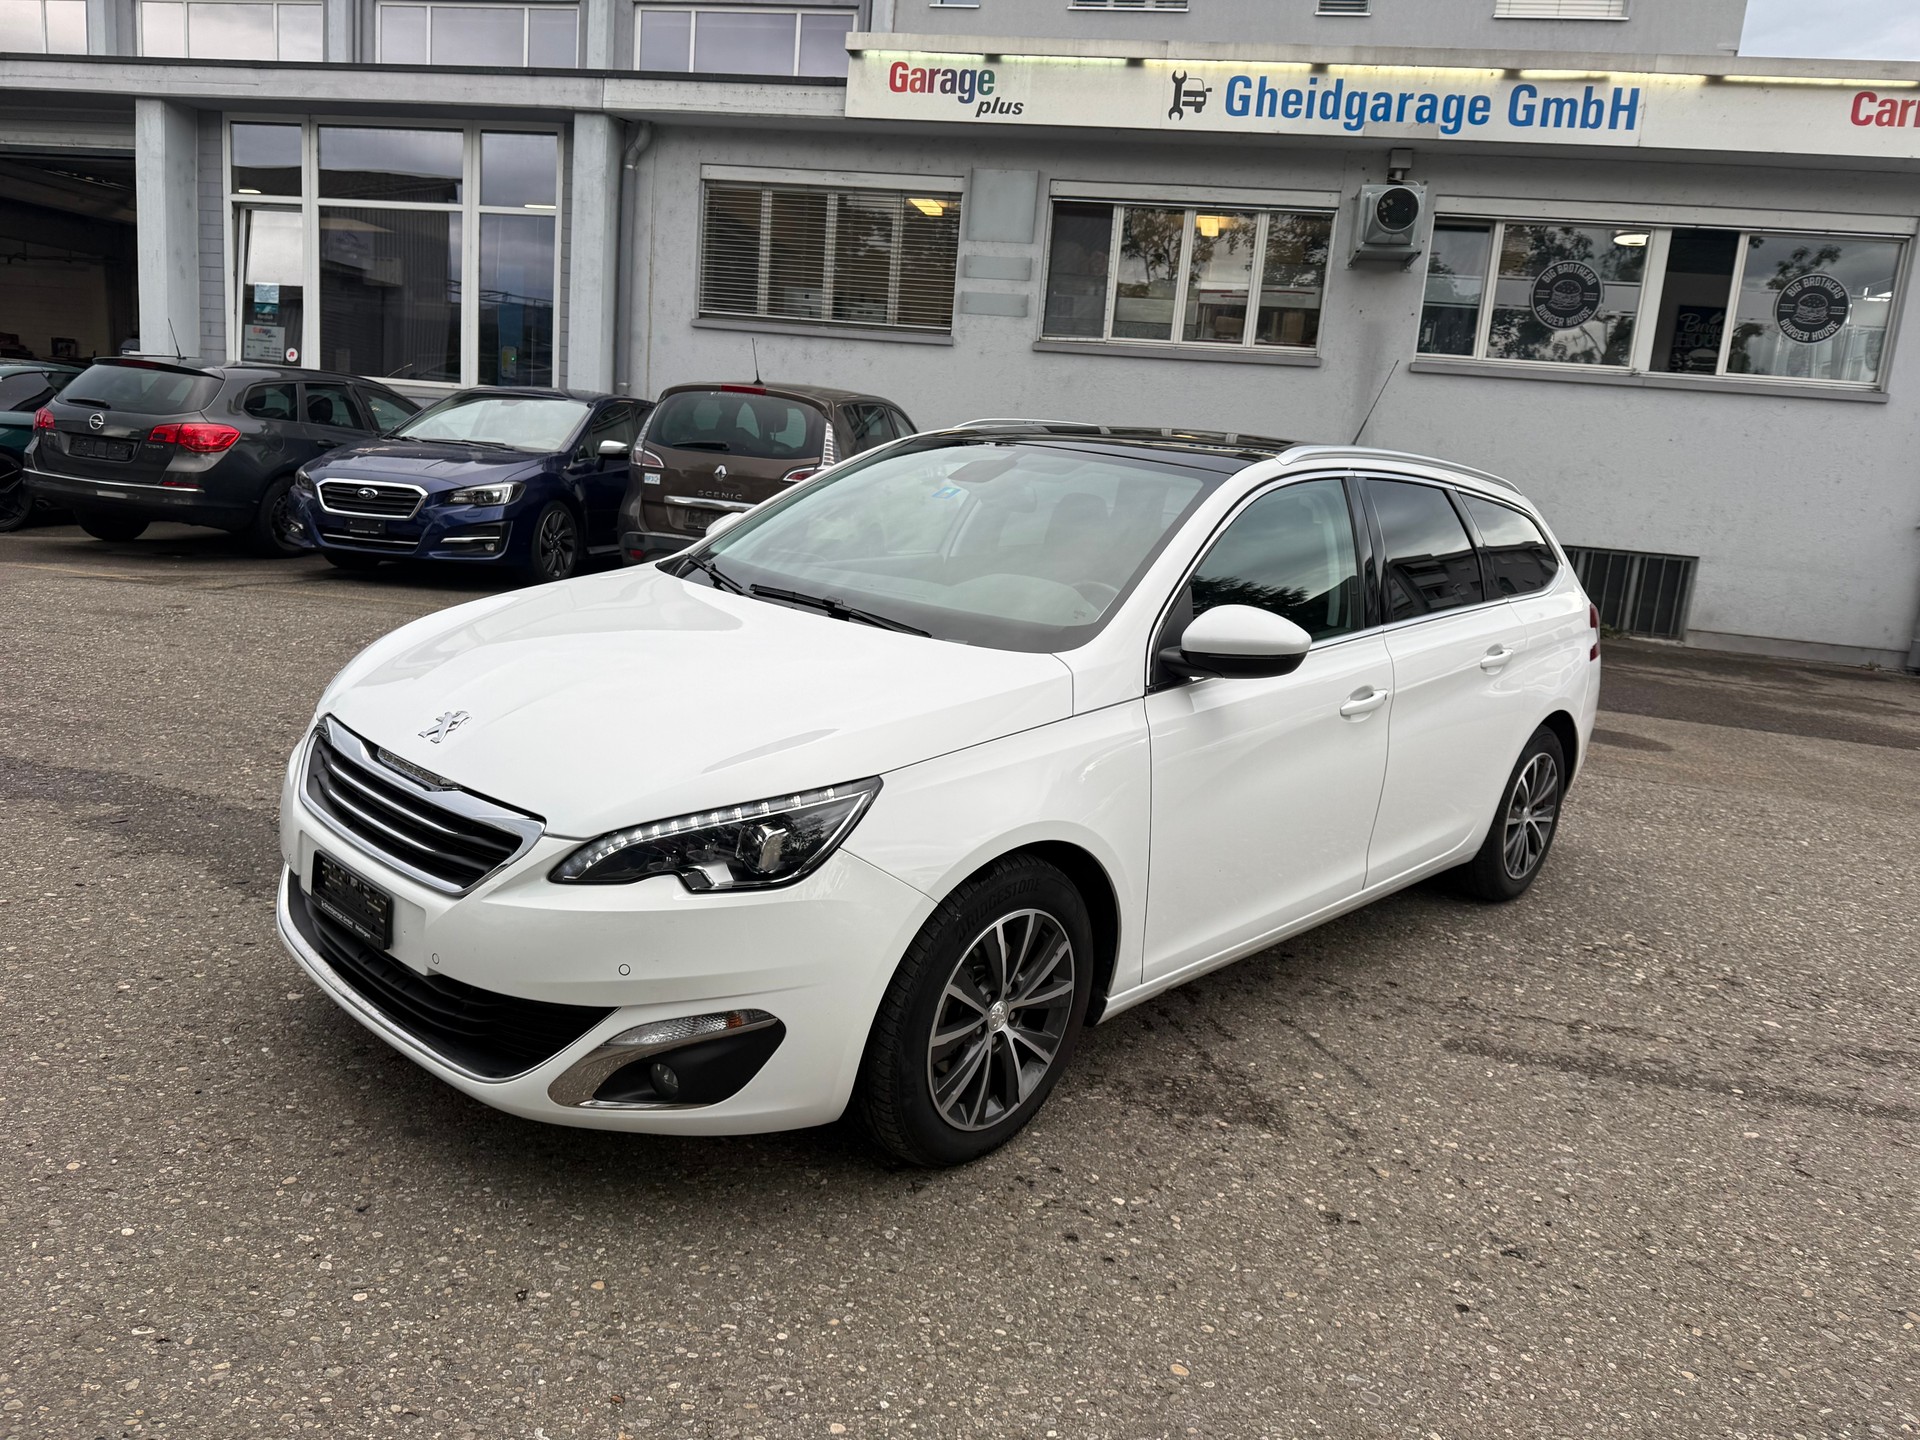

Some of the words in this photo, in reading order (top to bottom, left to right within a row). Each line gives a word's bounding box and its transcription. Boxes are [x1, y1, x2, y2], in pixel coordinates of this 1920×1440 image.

[889, 61, 995, 104] Garage
[975, 97, 1024, 118] plus
[1225, 75, 1492, 135] Gheidgarage
[1508, 84, 1640, 131] GmbH
[1541, 268, 1558, 284] BIG
[1557, 263, 1597, 286] BROTHERS
[1786, 282, 1803, 297] BIG
[1802, 276, 1845, 299] BROTHERS
[1536, 304, 1565, 327] BURGER
[1566, 306, 1593, 327] HOUSE
[1780, 318, 1810, 342] BURGER
[1811, 320, 1840, 342] HOUSE
[697, 489, 743, 500] SCENIC
